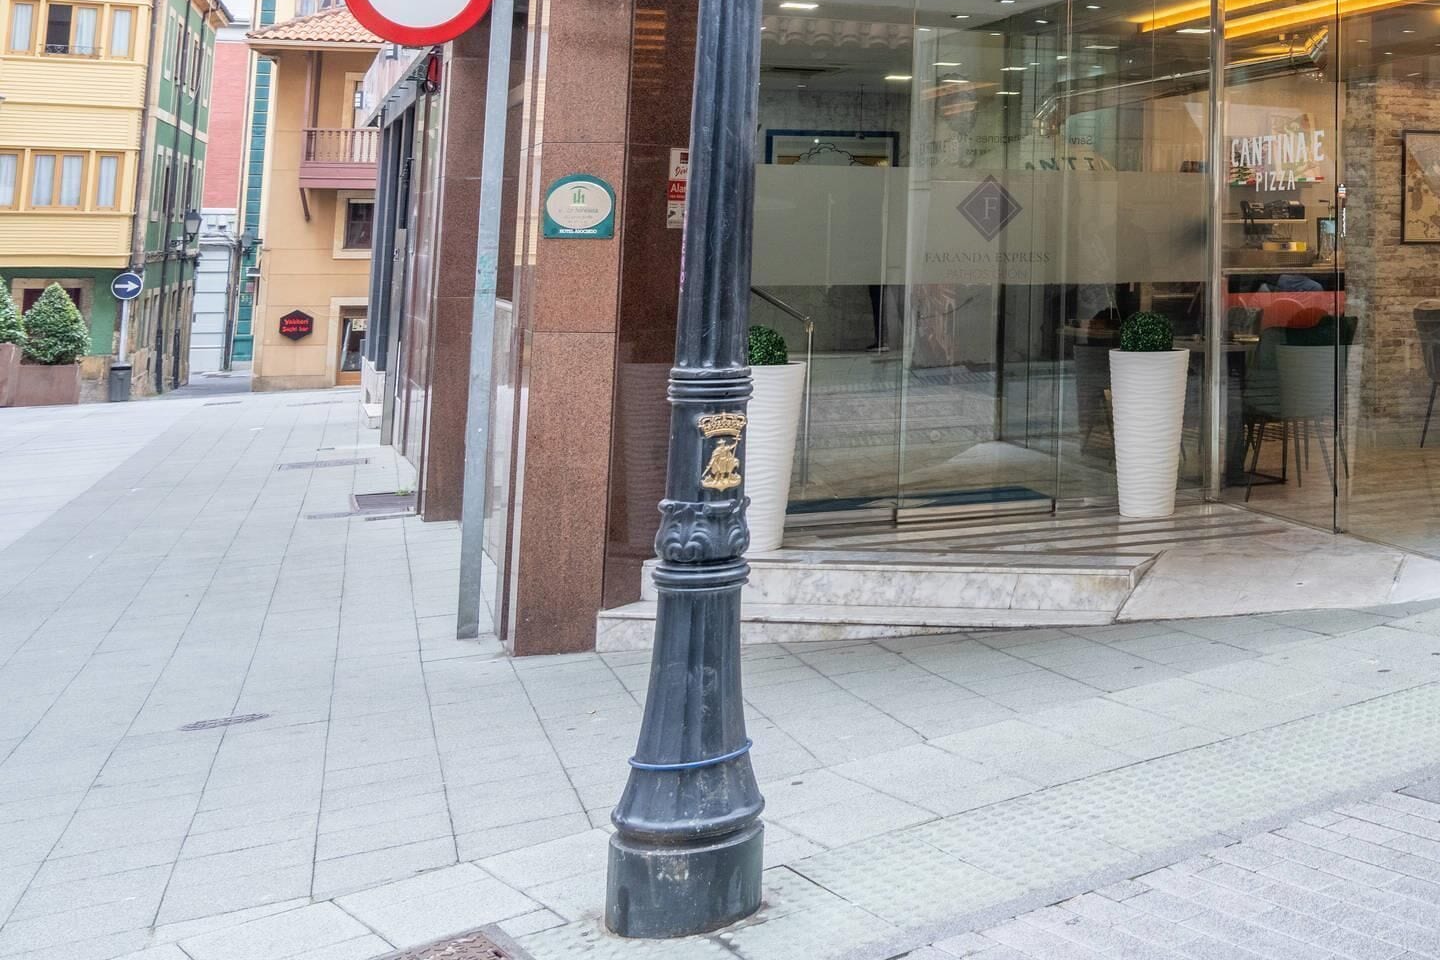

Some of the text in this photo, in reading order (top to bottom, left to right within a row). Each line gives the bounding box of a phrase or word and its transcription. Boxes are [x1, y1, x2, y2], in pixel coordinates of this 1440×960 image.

[1231, 129, 1326, 168] CANTINA E
[1255, 170, 1297, 192] PIZZA
[981, 196, 999, 220] F
[924, 250, 1051, 263] FARANDA EXPRESS
